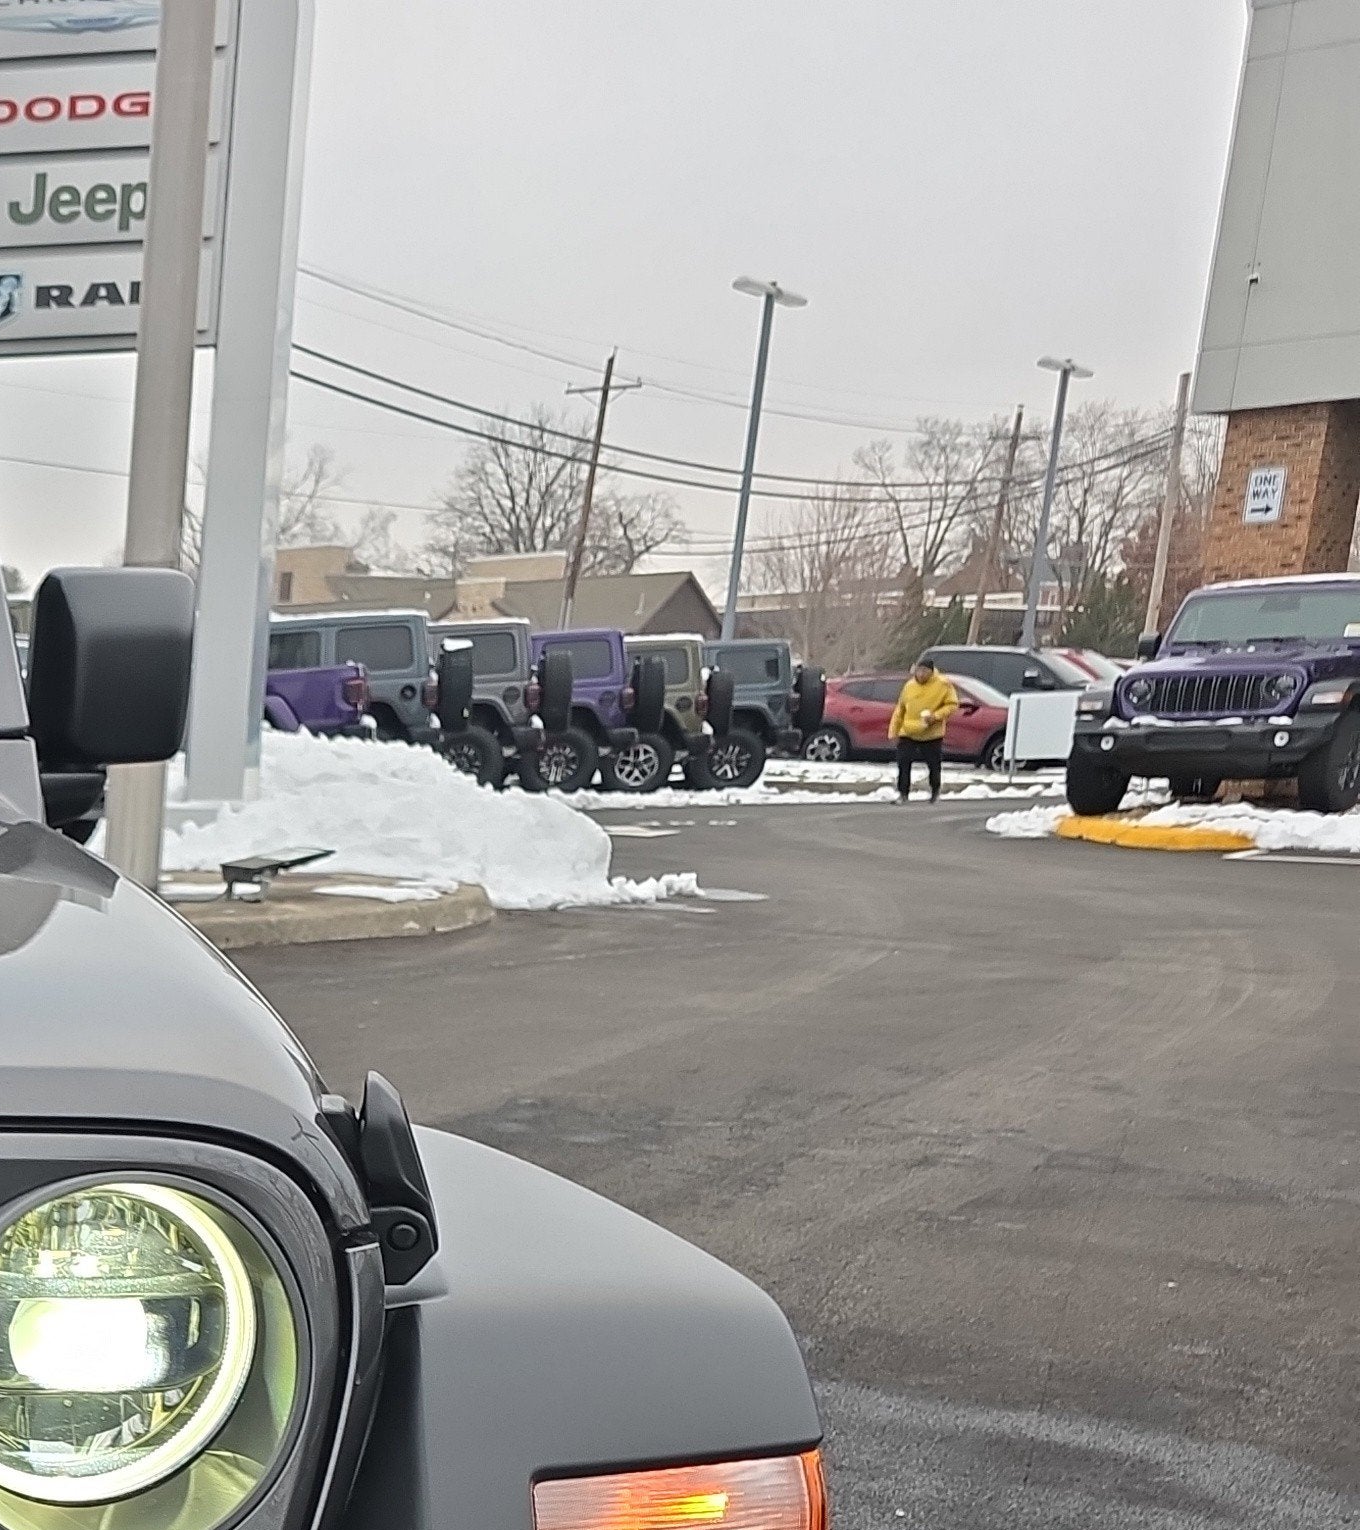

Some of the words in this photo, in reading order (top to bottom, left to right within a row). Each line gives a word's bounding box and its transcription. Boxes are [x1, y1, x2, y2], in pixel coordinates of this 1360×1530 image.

[8, 172, 148, 232] Jeep
[1253, 474, 1277, 487] ONE
[1252, 487, 1279, 501] WAY
